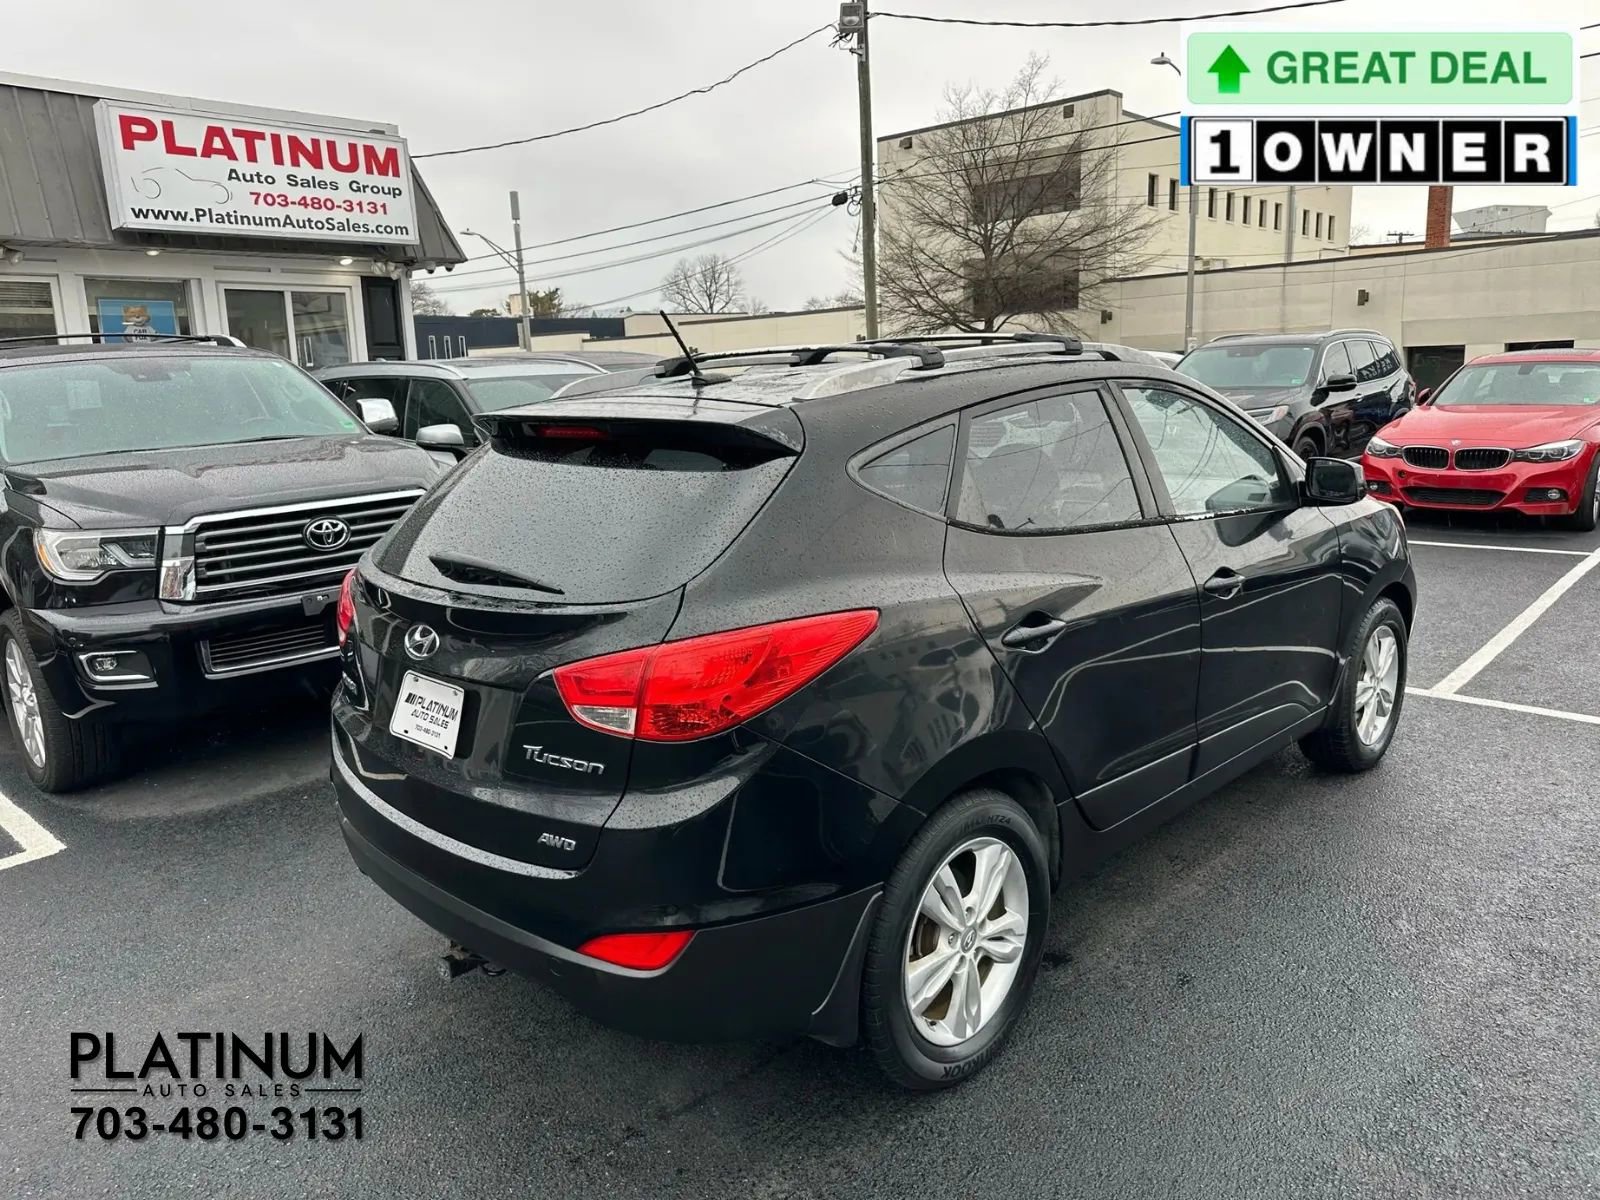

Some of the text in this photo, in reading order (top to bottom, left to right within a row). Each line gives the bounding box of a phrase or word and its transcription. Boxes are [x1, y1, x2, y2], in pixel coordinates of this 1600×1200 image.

[118, 114, 401, 179] PLATINUM
[227, 168, 402, 198] Auto Sales Group
[249, 191, 388, 215] 703-480-3131
[131, 207, 409, 236] www.PlatinumAutoSales.com
[411, 709, 449, 729] AUTO SALES
[416, 696, 457, 721] PLATINUM
[523, 744, 605, 775] Tucson
[537, 832, 577, 851] AWD
